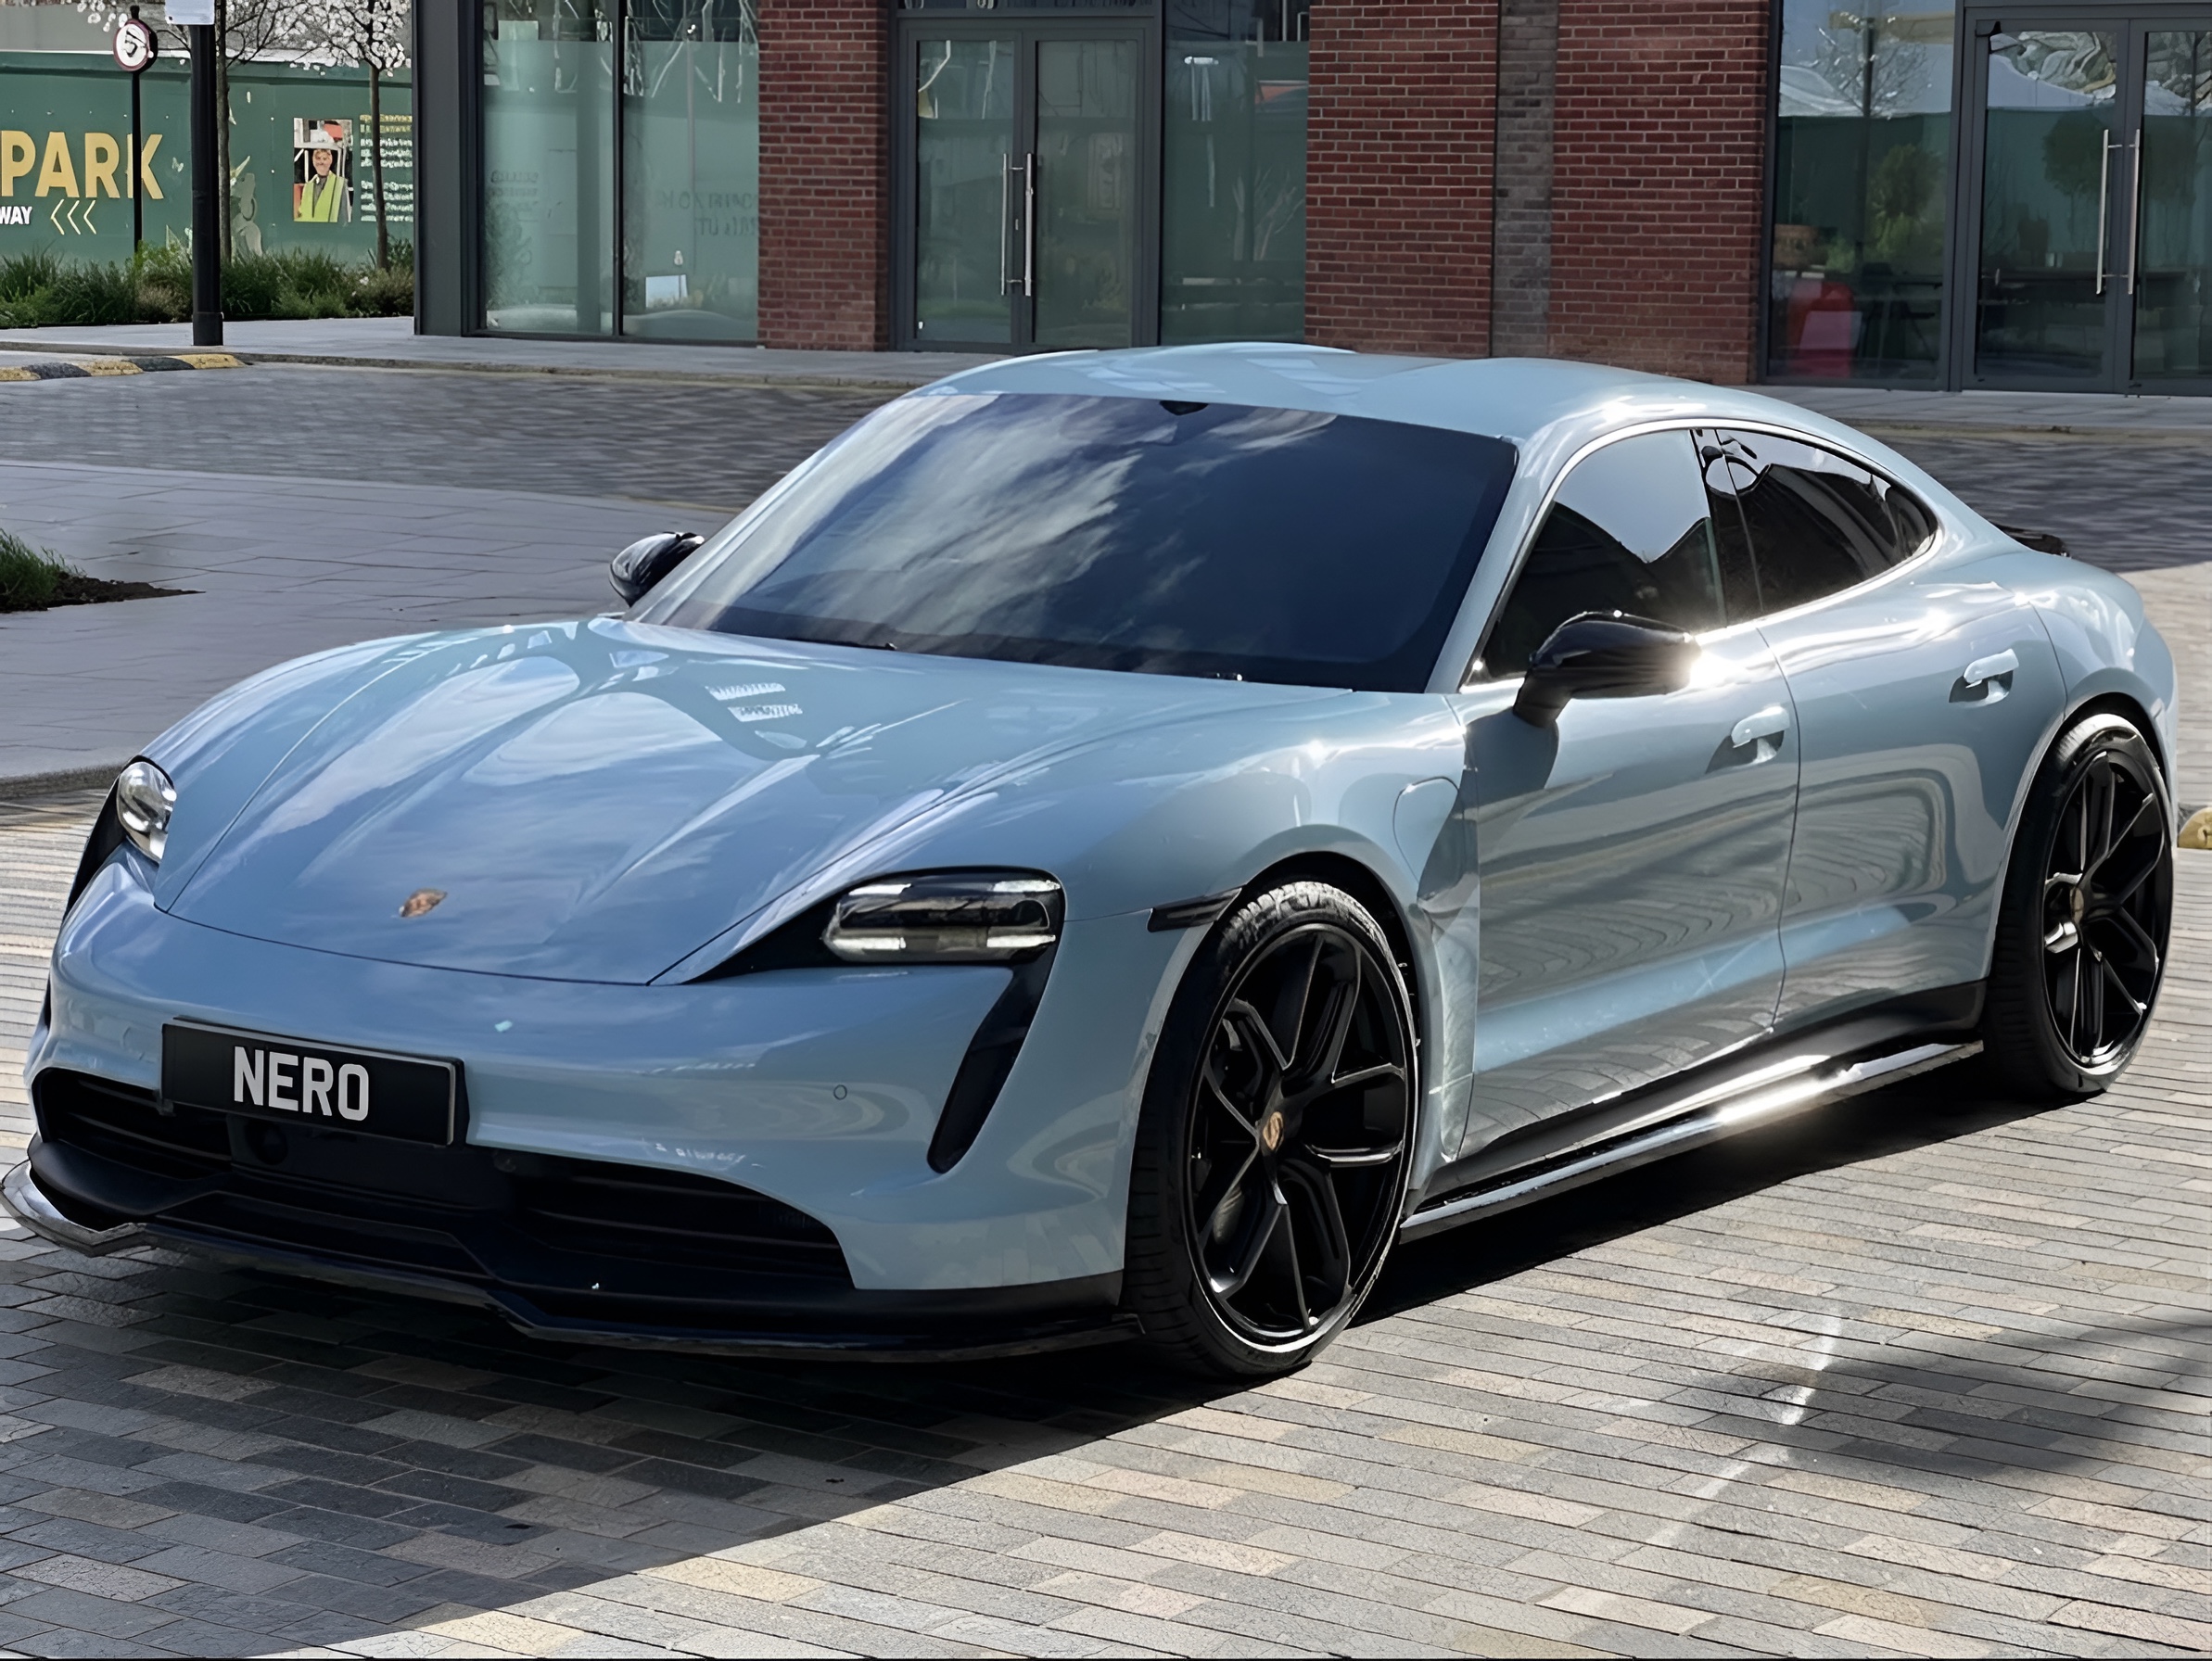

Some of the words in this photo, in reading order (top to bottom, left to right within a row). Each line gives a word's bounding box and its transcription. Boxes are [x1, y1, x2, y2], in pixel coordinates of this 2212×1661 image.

[0, 130, 164, 200] PARK
[0, 206, 32, 225] WAY
[234, 1046, 369, 1122] NERO
